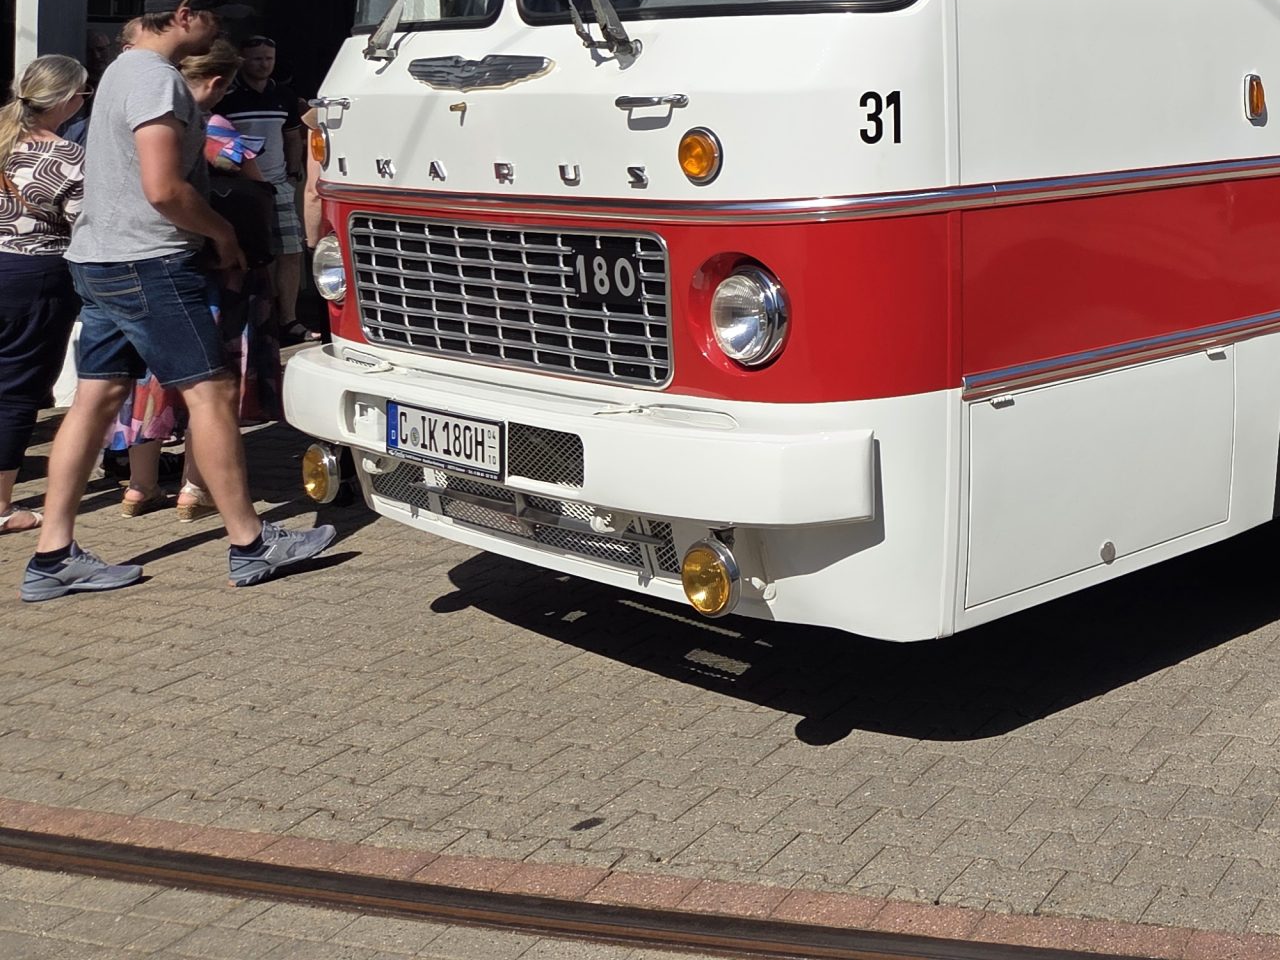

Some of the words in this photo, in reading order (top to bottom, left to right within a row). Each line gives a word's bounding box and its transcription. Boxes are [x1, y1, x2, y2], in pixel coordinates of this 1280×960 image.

[860, 91, 901, 144] 31
[338, 156, 649, 189] IKARUS
[576, 255, 635, 297] 180
[442, 422, 485, 463] 180H
